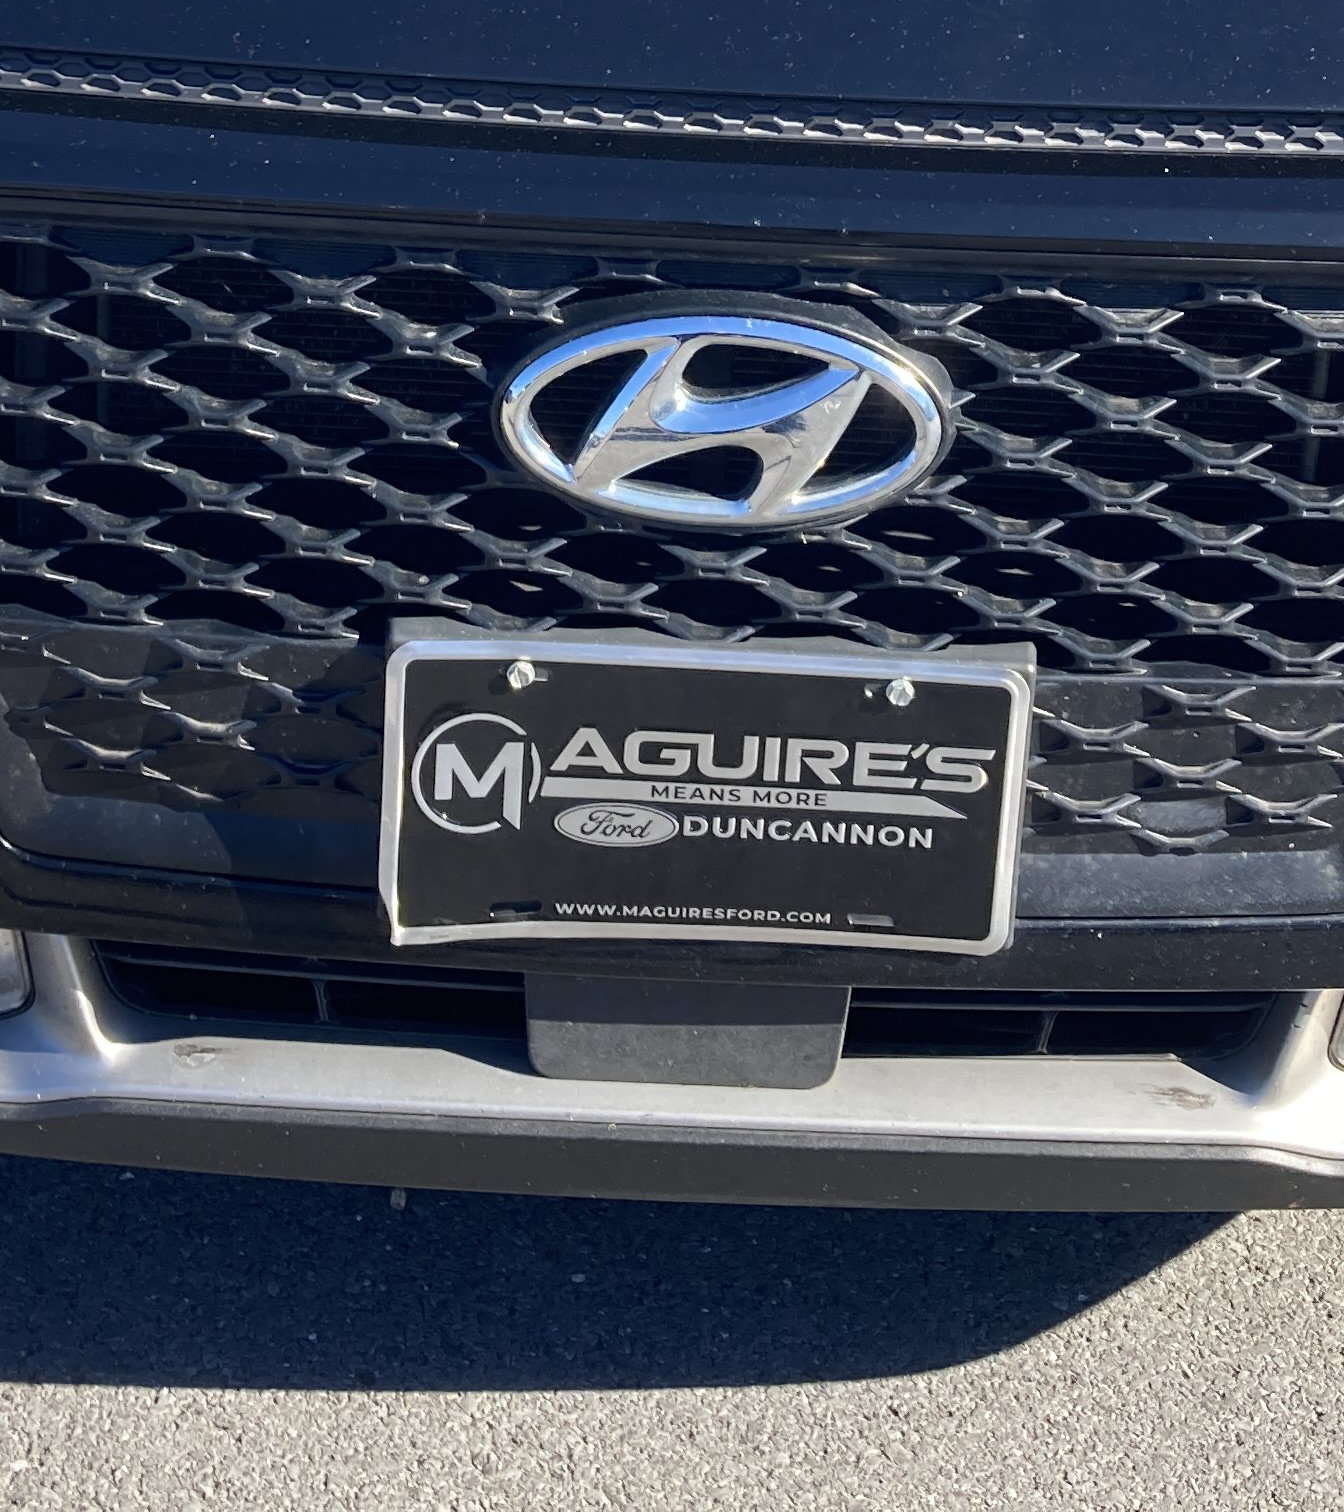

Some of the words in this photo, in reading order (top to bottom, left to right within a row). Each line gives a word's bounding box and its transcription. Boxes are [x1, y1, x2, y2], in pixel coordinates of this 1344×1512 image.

[650, 783, 742, 804] MEANS
[751, 787, 828, 807] MORE
[579, 808, 655, 841] Ford
[681, 814, 934, 849] DUNCANNON
[554, 901, 832, 925] WWW.MAGUIRESFORD.COM
